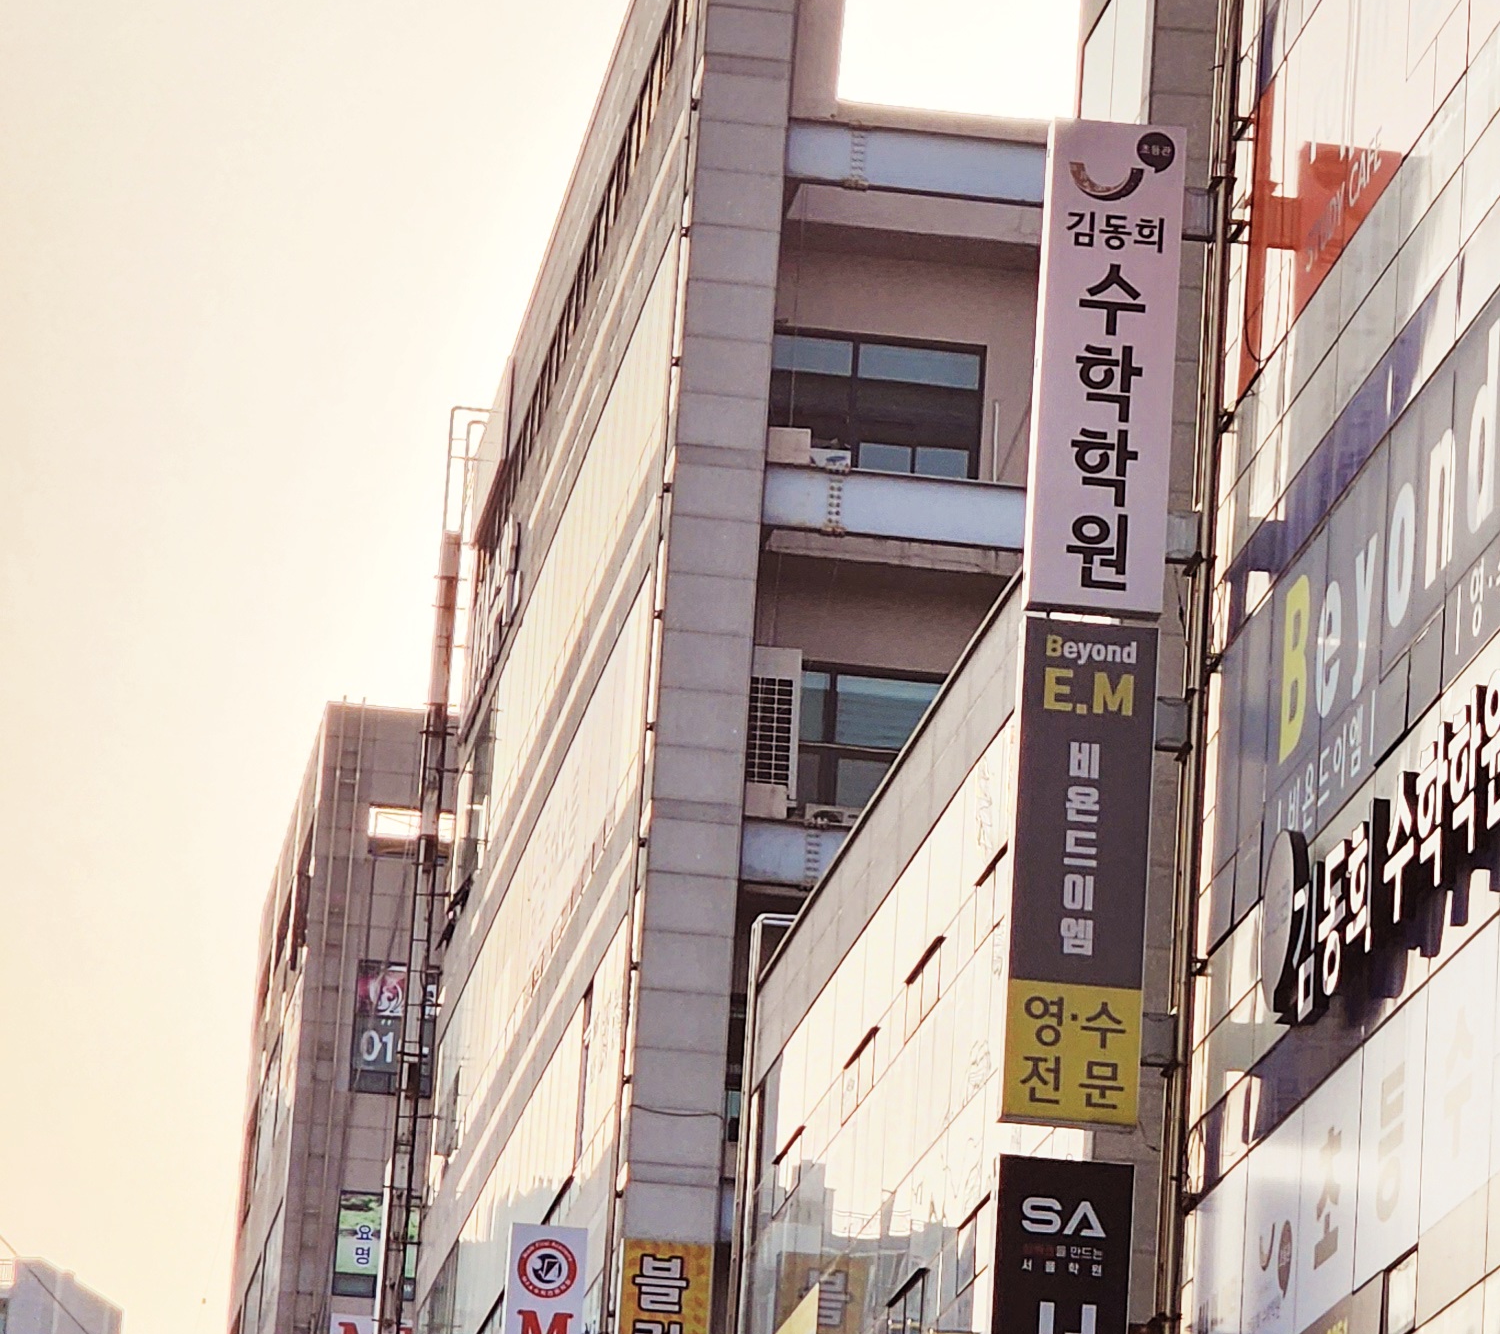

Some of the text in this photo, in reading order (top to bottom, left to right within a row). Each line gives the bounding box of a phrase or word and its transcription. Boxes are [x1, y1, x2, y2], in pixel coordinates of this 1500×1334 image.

[1065, 210, 1165, 253] 김동희
[1066, 263, 1146, 592] 수학학원
[1045, 633, 1137, 665] Beyond
[1042, 668, 1135, 717] E.M
[1059, 740, 1101, 957] 비욘드이엠
[1293, 822, 1373, 1023] 김동희
[1019, 1055, 1126, 1111] 전문
[1021, 1196, 1107, 1238] SA
